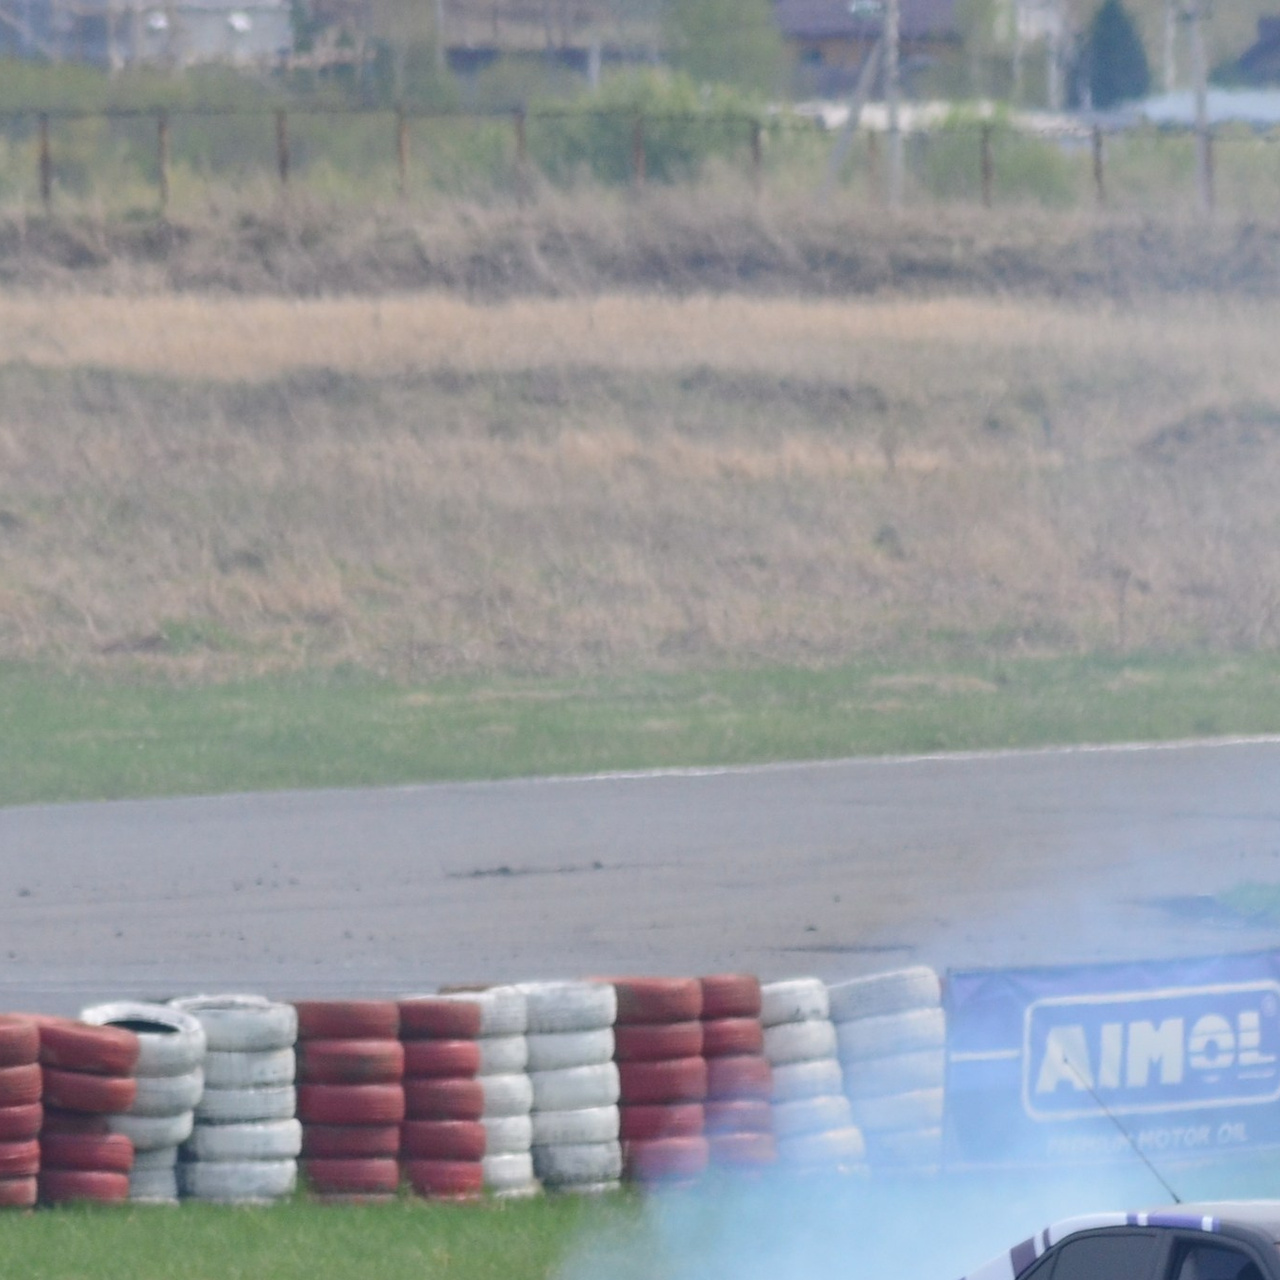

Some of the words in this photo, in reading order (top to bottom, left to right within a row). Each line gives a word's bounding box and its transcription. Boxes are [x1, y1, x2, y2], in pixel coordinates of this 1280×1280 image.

[1036, 1011, 1276, 1093] AIMOL
[1138, 1126, 1211, 1150] MOTOR
[1217, 1122, 1248, 1145] OIL
